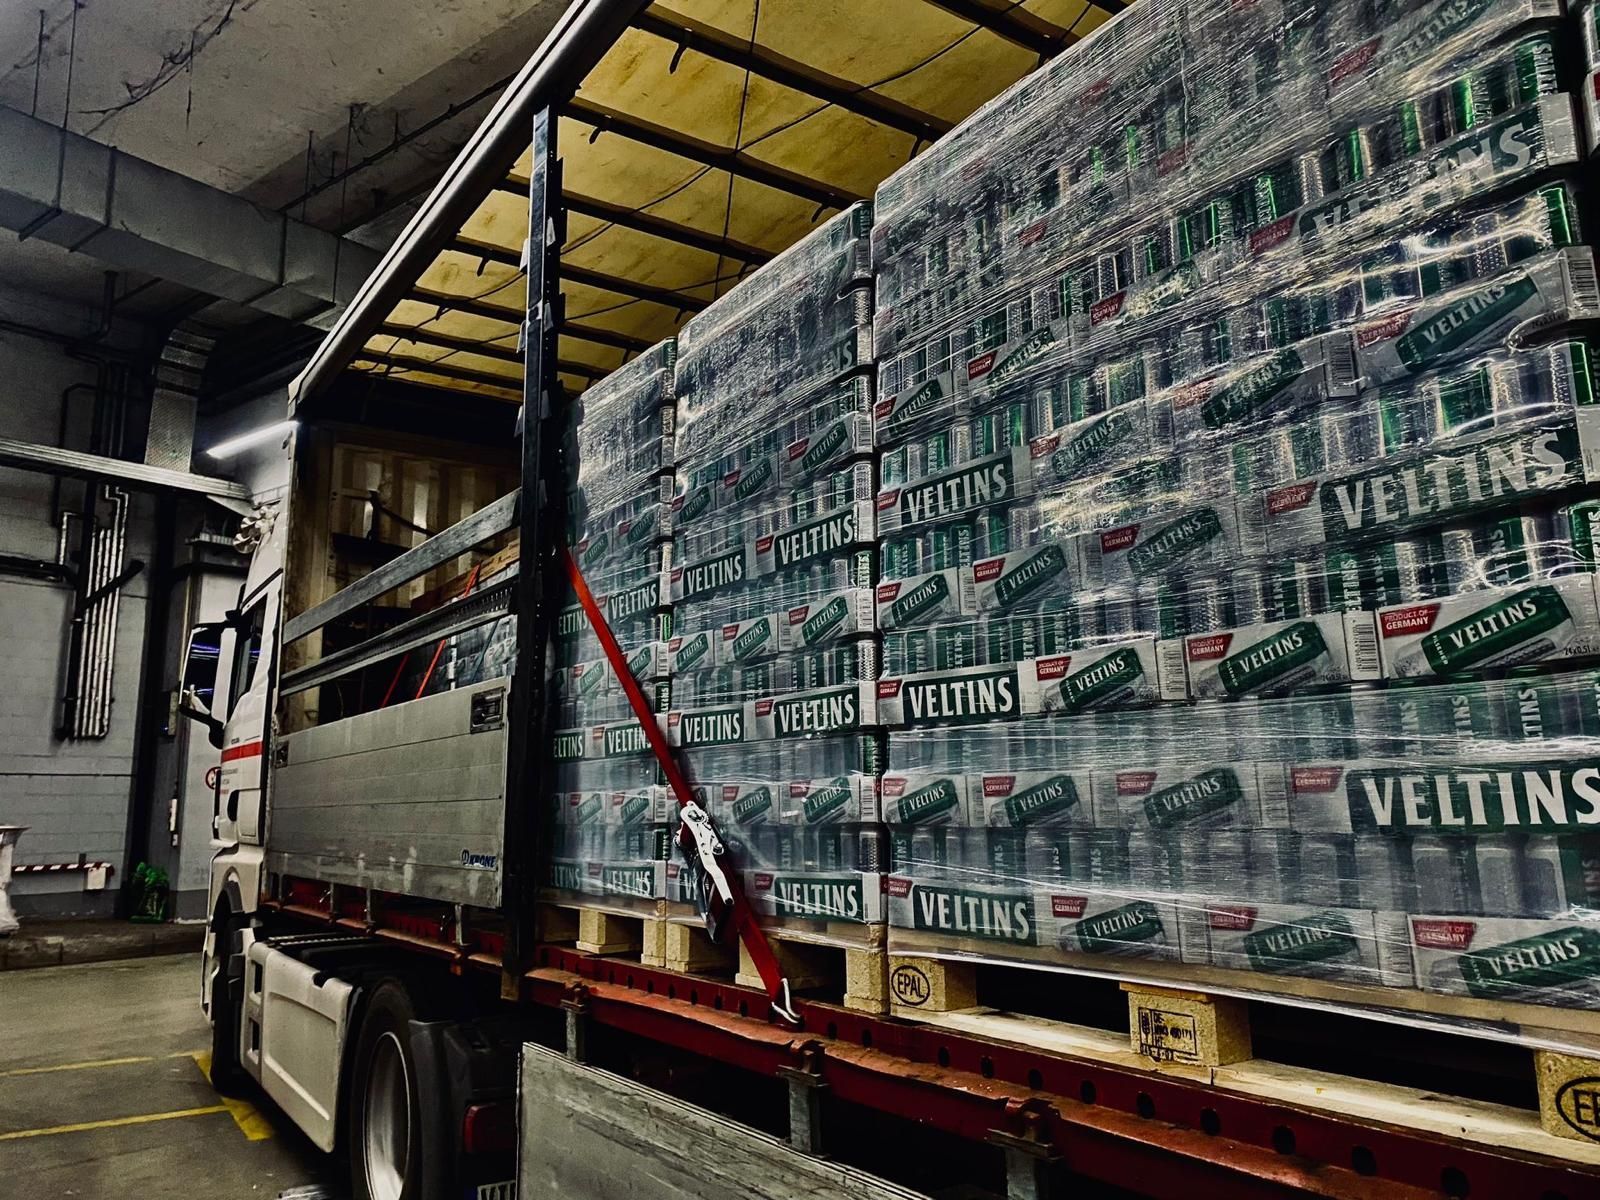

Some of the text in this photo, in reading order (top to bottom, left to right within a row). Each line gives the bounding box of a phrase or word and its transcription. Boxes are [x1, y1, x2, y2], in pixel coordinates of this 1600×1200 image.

[969, 361, 992, 374] GERMANY
[1000, 338, 1041, 377] VELTINS
[898, 388, 931, 422] VELTINS
[810, 428, 839, 461] VELTINS
[1066, 416, 1114, 460] VELTINS
[906, 463, 1007, 522] VELTINS
[1333, 431, 1566, 530] VELTINS
[779, 513, 853, 566] VELTINS
[958, 529, 970, 568] ELTINS
[1104, 534, 1133, 547] GERMANY
[1147, 516, 1200, 560] VELTINS
[686, 554, 742, 594] VELTINS
[976, 567, 999, 578] GERMANY
[1008, 553, 1051, 589] VELTINS
[611, 583, 657, 619] VELTINS
[878, 590, 896, 599] GERMANY
[903, 583, 937, 611] VELTINS
[558, 609, 588, 635] ELTINS
[810, 603, 839, 631] VELTINS
[1384, 612, 1417, 622] PRODUCT
[1386, 616, 1429, 630] GERMANY
[1449, 599, 1538, 649] VELTINS
[682, 638, 702, 660] VELTINS
[740, 623, 763, 647] VELTINS
[1191, 639, 1214, 648] PRODUCT
[1192, 644, 1224, 655] GERMANY
[1239, 633, 1303, 673] VELTINS
[1039, 665, 1065, 675] GERMANY
[1075, 656, 1125, 692] VELTINS
[909, 677, 1013, 718] VELTINS
[779, 693, 855, 733] VELTINS
[608, 727, 652, 753] VELTIN
[684, 713, 741, 743] VELTINS
[740, 790, 764, 812] VELTINS
[812, 783, 841, 808] VELTINS
[909, 785, 945, 810] VELTINS
[985, 783, 1011, 791] GERMANY
[1020, 782, 1063, 811] VELTINS
[1162, 776, 1221, 811] VELTINS
[1361, 767, 1600, 825] VELTINS
[780, 882, 858, 917] VELTINS
[1055, 904, 1080, 912] GERMANY
[919, 891, 1030, 939] VELTINS
[1093, 909, 1144, 937] VELTINS
[1265, 922, 1332, 952] VELTINS
[1419, 932, 1465, 943] GERMANY
[1488, 937, 1581, 976] VELTINS
[897, 972, 925, 998] EPAL
